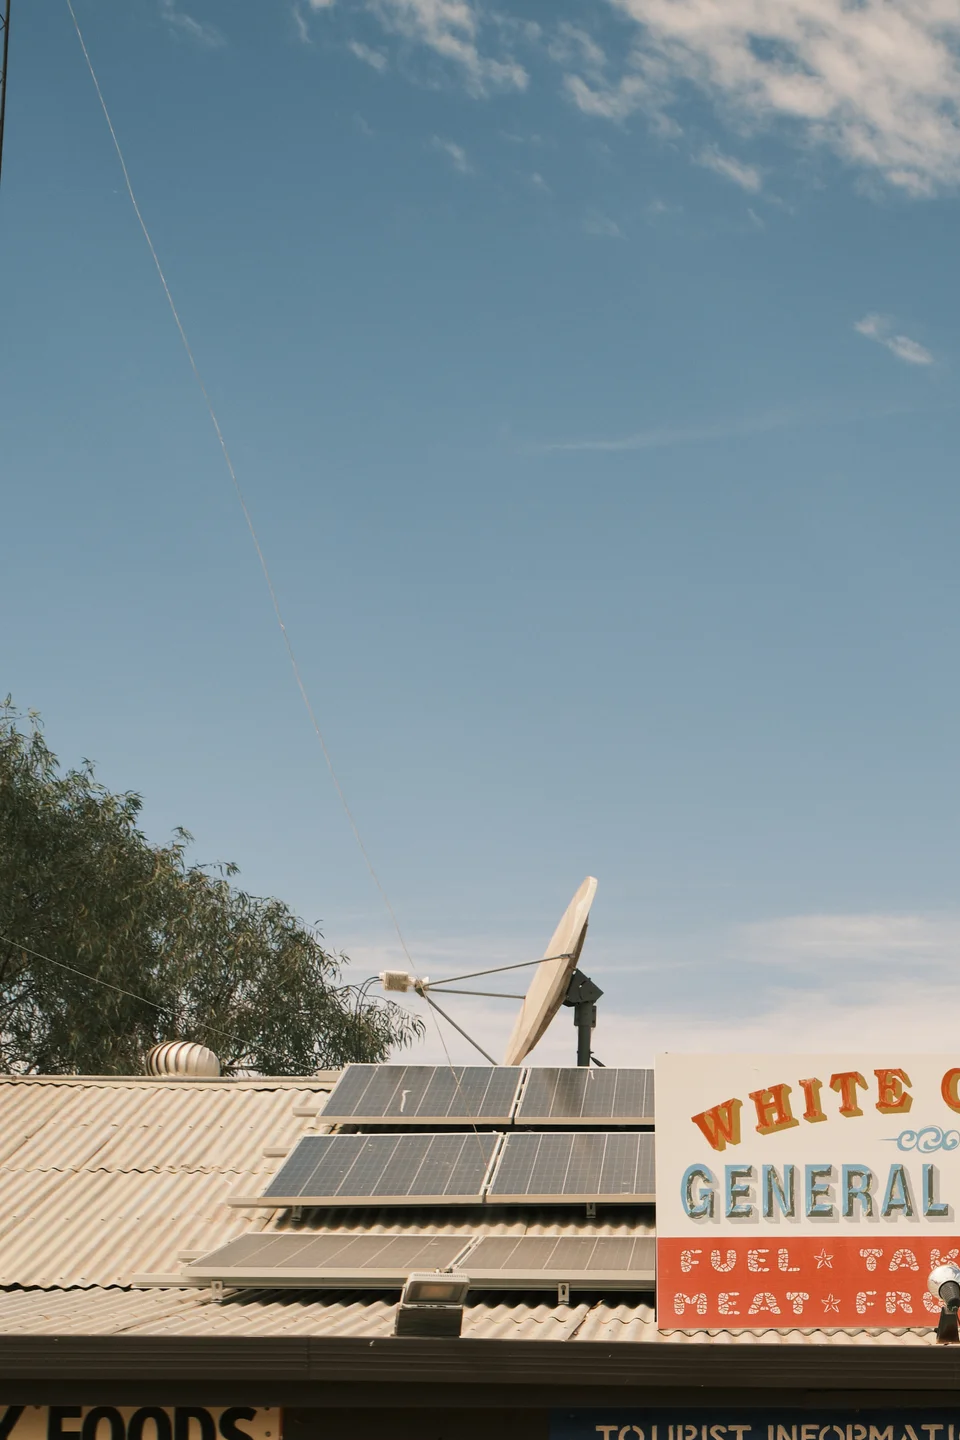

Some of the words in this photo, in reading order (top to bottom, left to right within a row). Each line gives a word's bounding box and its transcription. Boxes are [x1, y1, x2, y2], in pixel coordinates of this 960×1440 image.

[690, 1067, 913, 1152] WHITE
[679, 1162, 953, 1222] GENERAL
[680, 1248, 801, 1273] FUEL
[674, 1292, 810, 1316] MEAT
